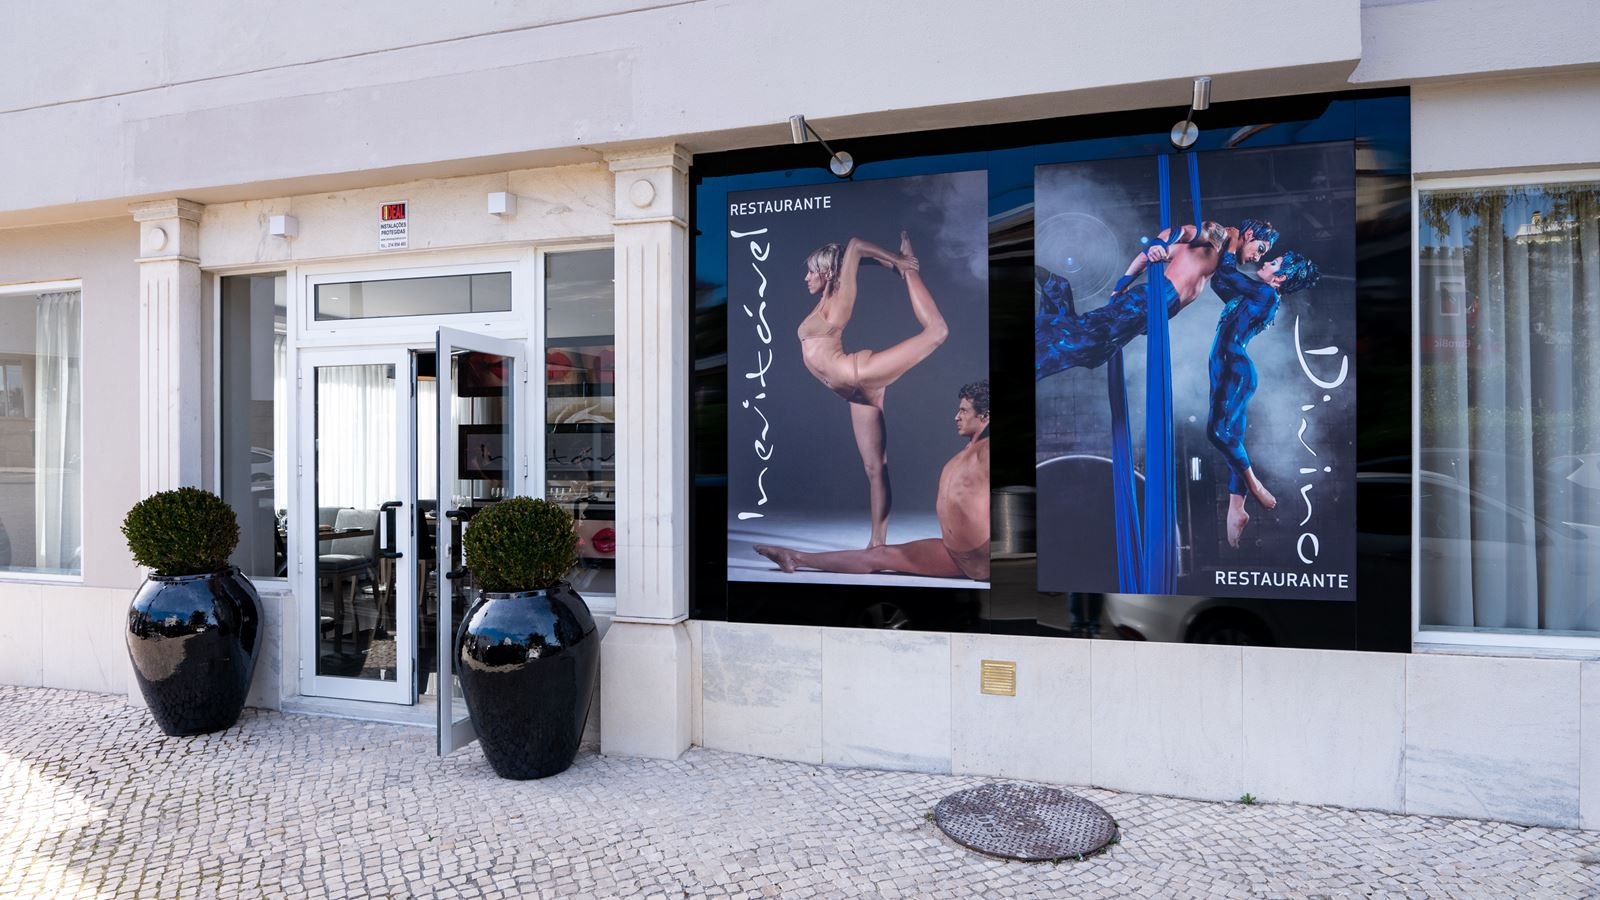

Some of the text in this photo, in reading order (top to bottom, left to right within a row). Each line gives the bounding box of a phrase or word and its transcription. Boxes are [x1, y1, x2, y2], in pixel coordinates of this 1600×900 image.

[383, 204, 405, 220] IDEAL
[730, 195, 832, 216] RESTAURANTE
[730, 228, 774, 520] Inevitável
[1294, 315, 1348, 564] Divino
[1215, 570, 1349, 589] RESTAURANTE
